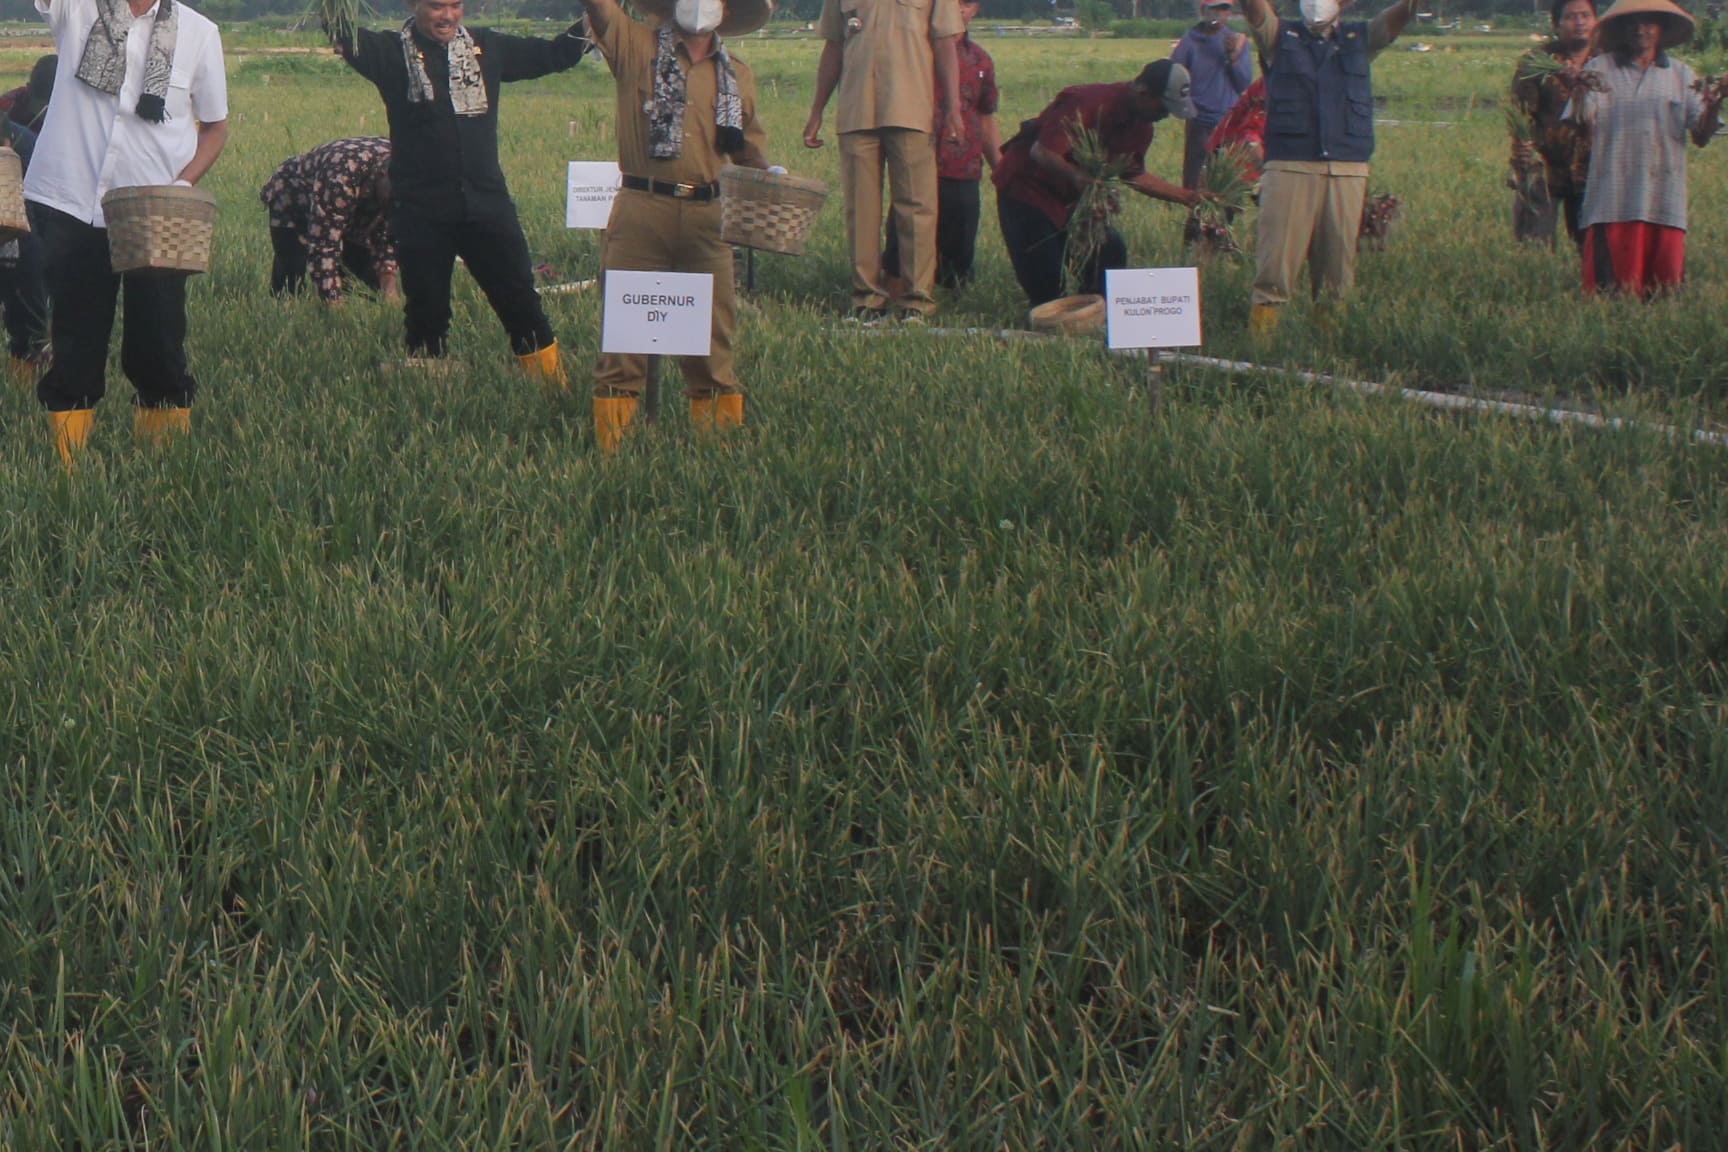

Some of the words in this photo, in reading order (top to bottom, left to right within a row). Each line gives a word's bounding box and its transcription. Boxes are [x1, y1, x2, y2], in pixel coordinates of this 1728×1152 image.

[622, 294, 695, 307] GUBERNUR
[1115, 296, 1157, 305] PENJABAT
[1160, 295, 1190, 304] BUPATI
[647, 311, 668, 322] DIY
[1124, 308, 1151, 316] KULON
[1153, 307, 1183, 316] PROGO
